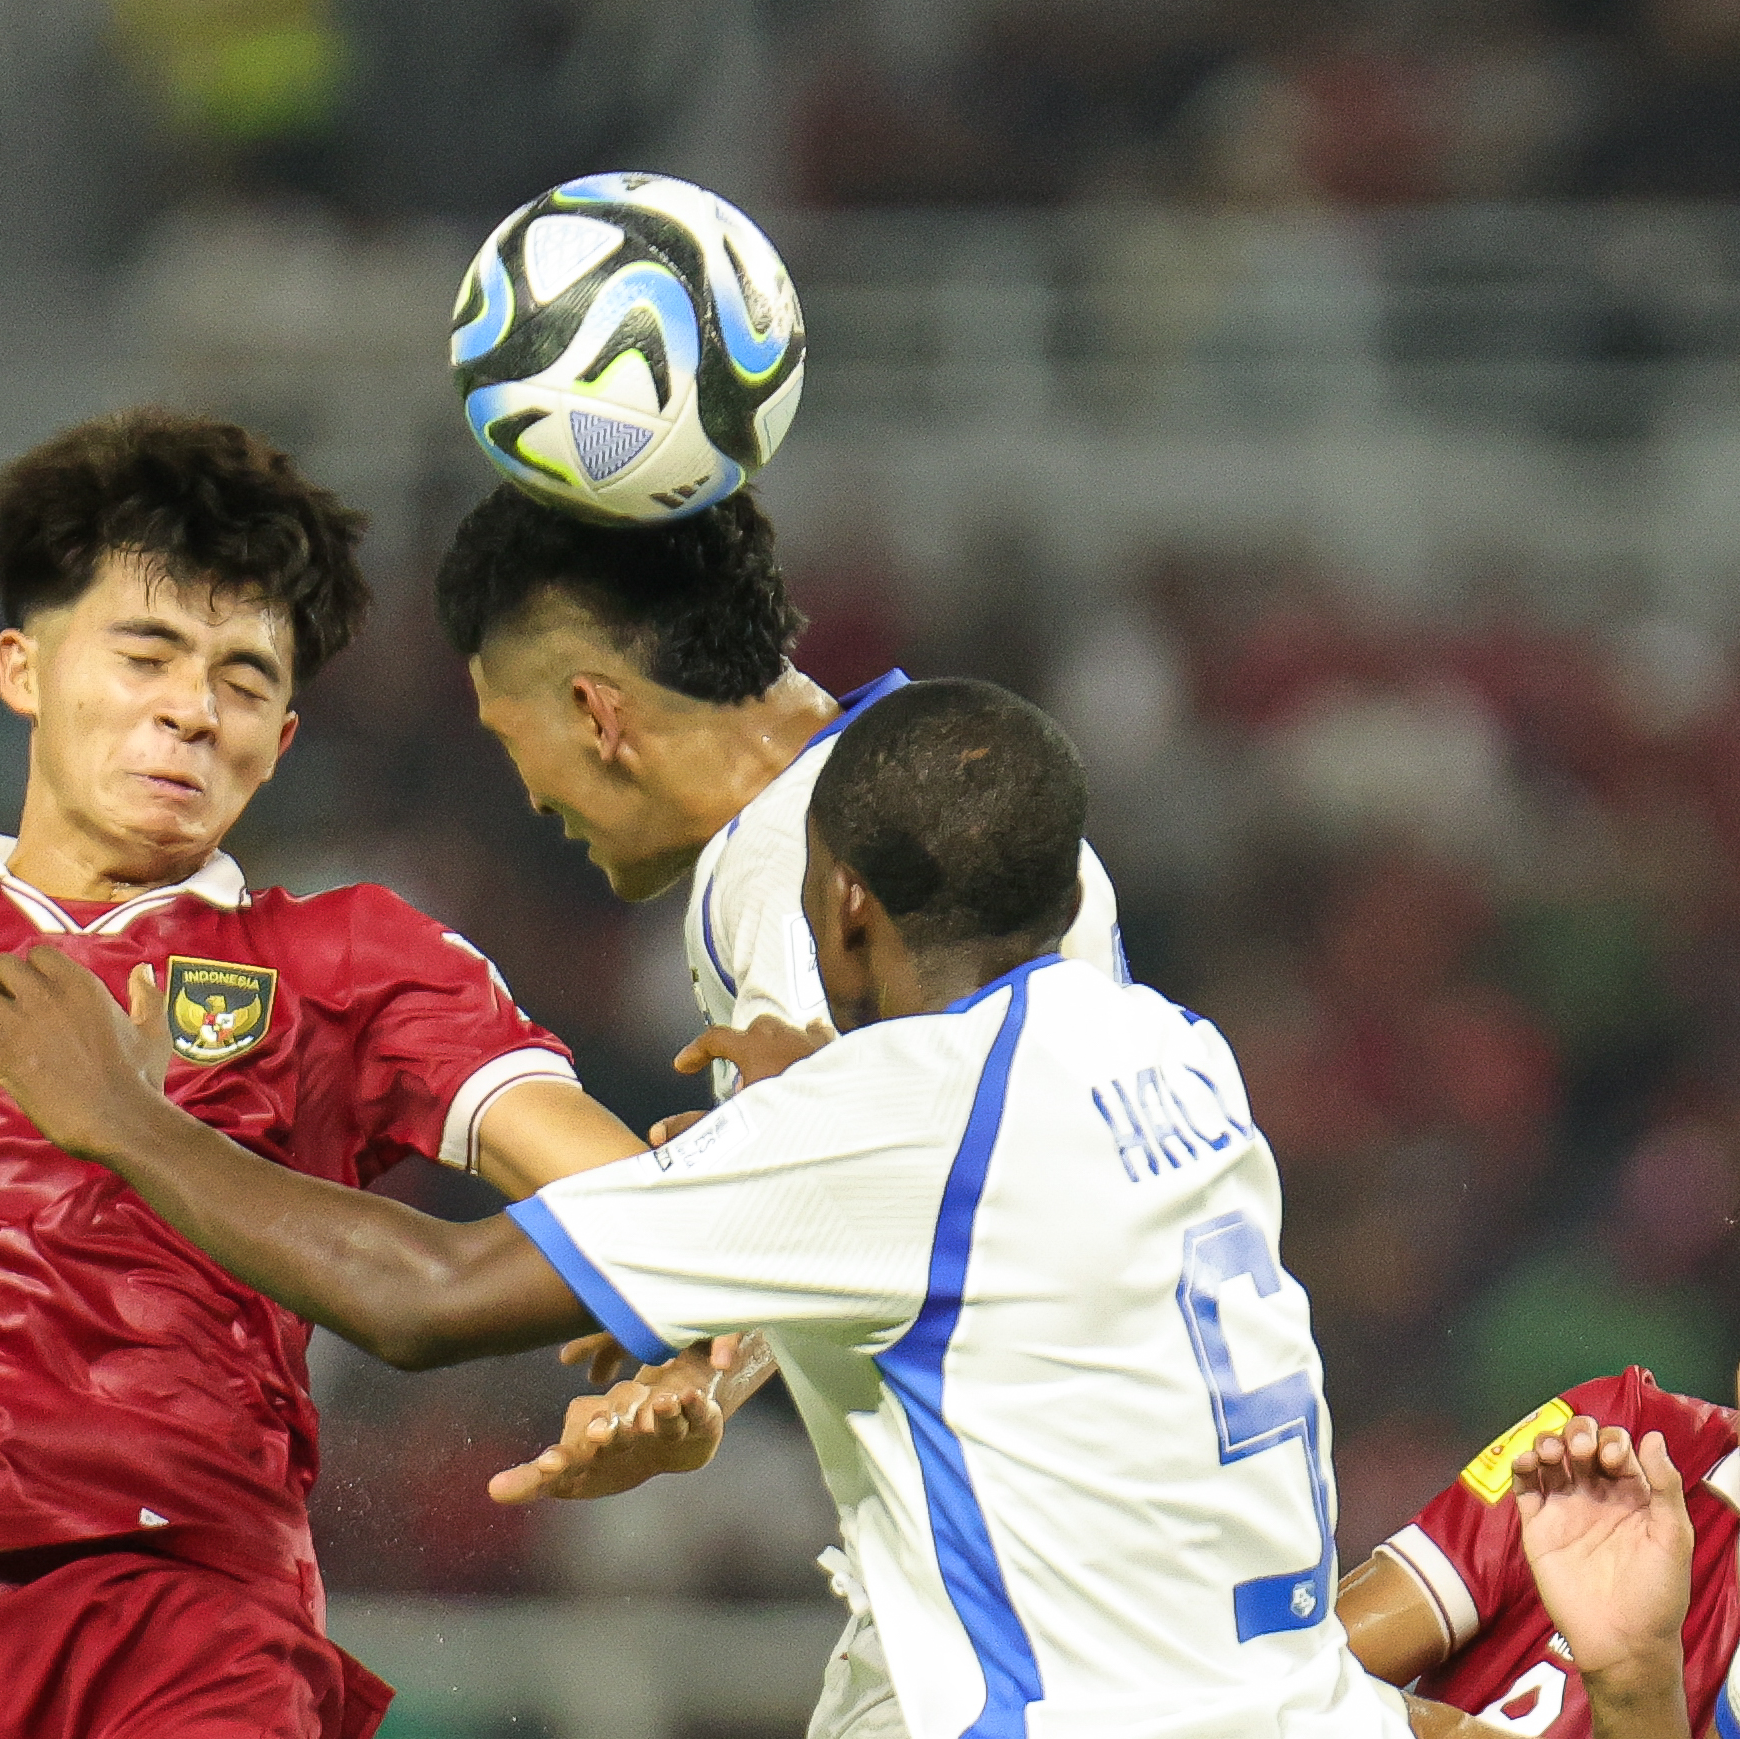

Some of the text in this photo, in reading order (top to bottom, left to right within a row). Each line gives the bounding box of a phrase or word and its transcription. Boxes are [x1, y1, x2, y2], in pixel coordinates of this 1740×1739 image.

[183, 970, 260, 991] INDONESIA
[1175, 1207, 1338, 1643] 5
[1547, 1631, 1576, 1662] MIL
